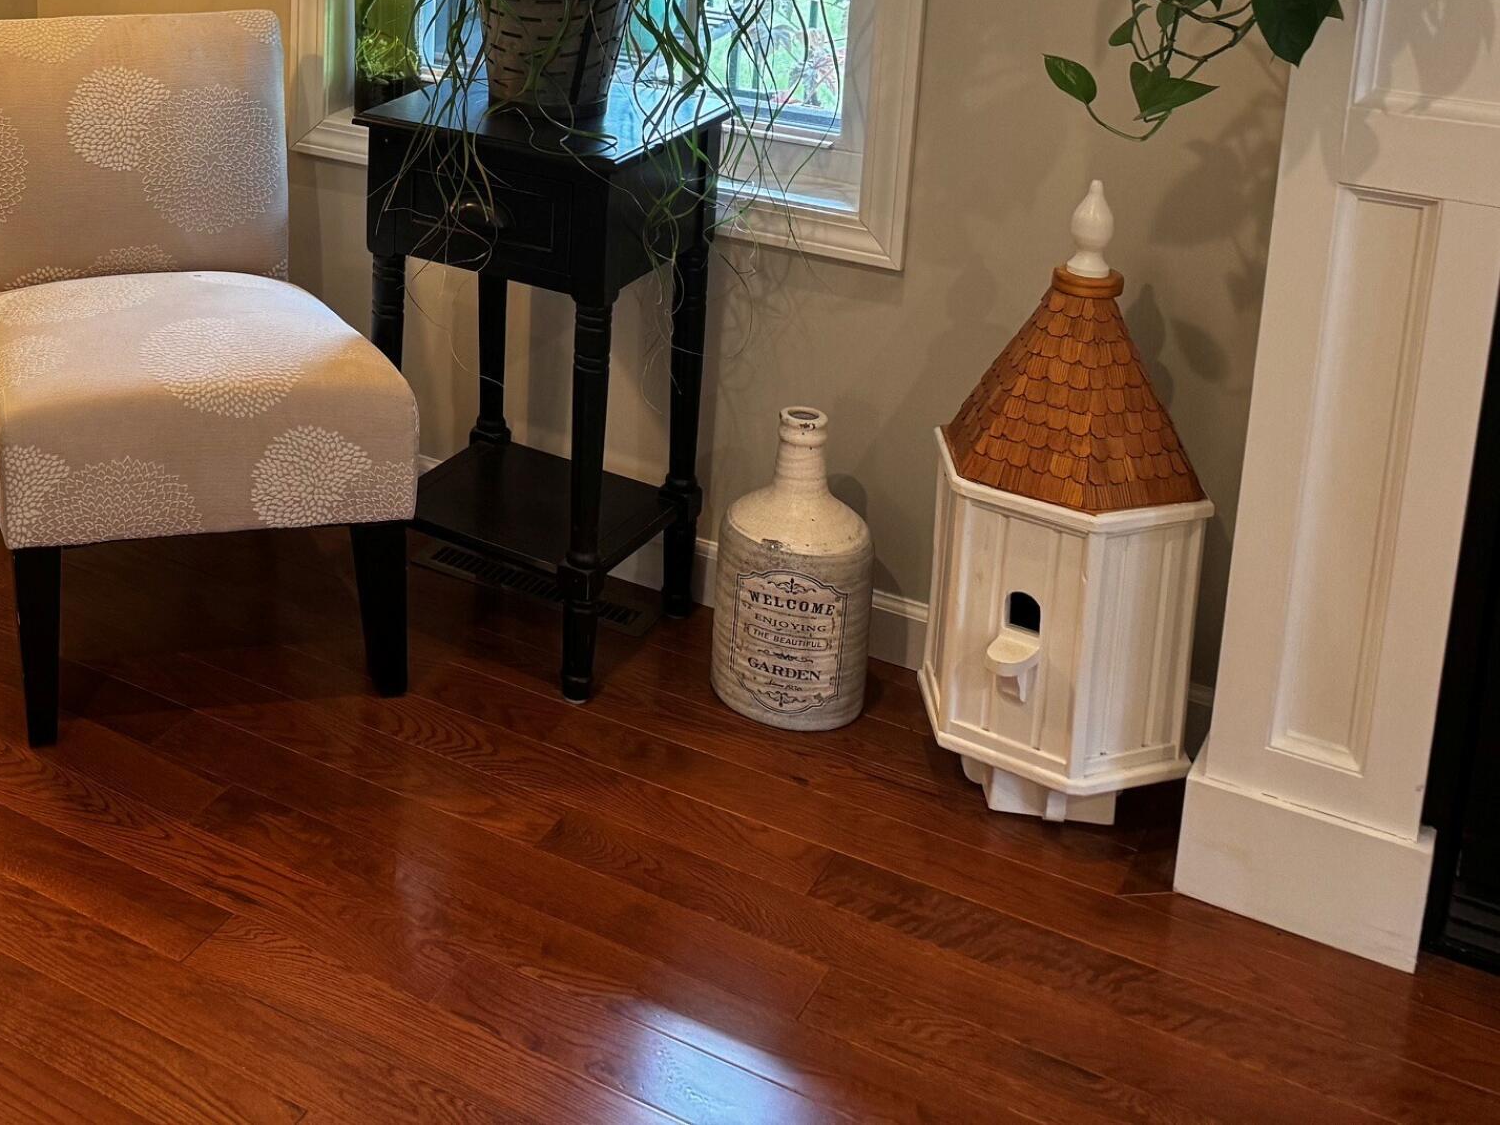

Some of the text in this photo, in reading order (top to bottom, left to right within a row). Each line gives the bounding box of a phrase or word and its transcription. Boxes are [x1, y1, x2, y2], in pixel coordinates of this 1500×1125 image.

[750, 590, 835, 616] WELCOME
[755, 614, 827, 632] ENJOYING
[753, 629, 823, 648] THE BEAUTIFUL
[747, 656, 822, 681] GARDEN
